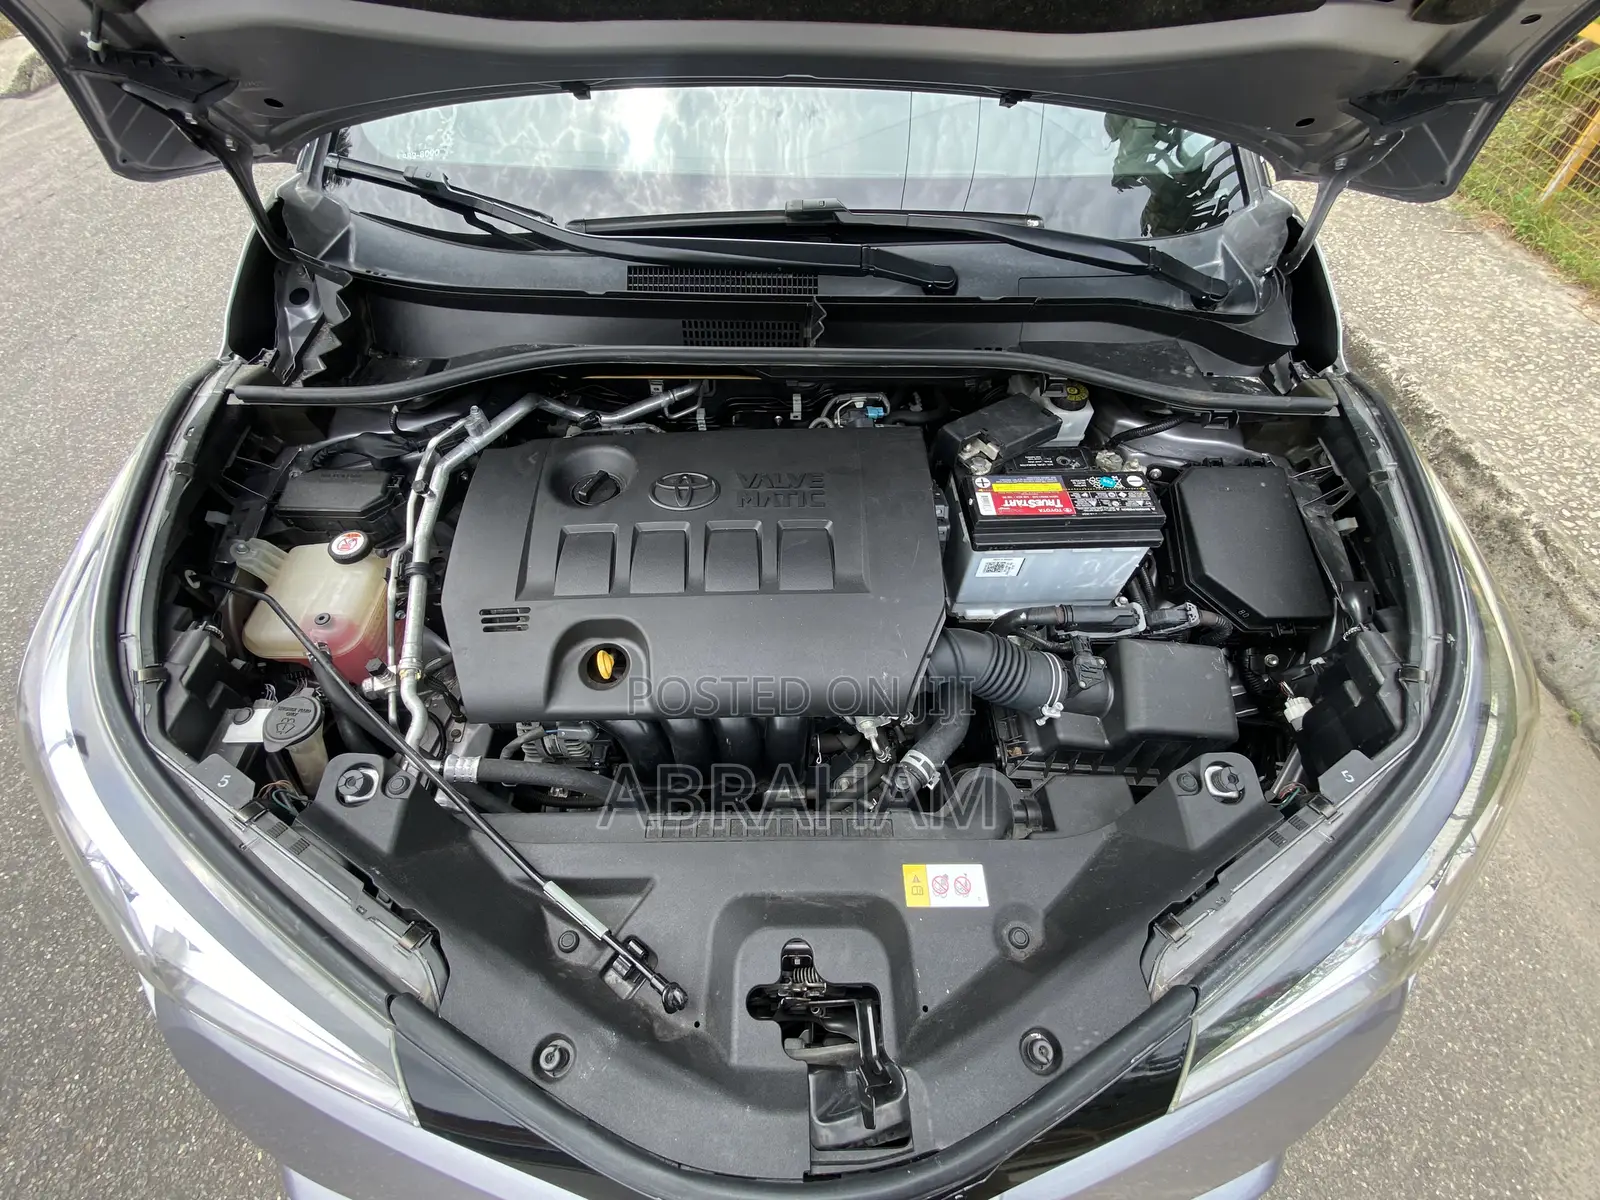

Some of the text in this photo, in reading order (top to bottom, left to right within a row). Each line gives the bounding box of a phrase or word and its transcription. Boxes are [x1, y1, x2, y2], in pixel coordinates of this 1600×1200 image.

[736, 472, 825, 490] VALVE
[737, 490, 826, 508] MATIC
[217, 774, 231, 788] 5
[1341, 770, 1355, 783] 5
